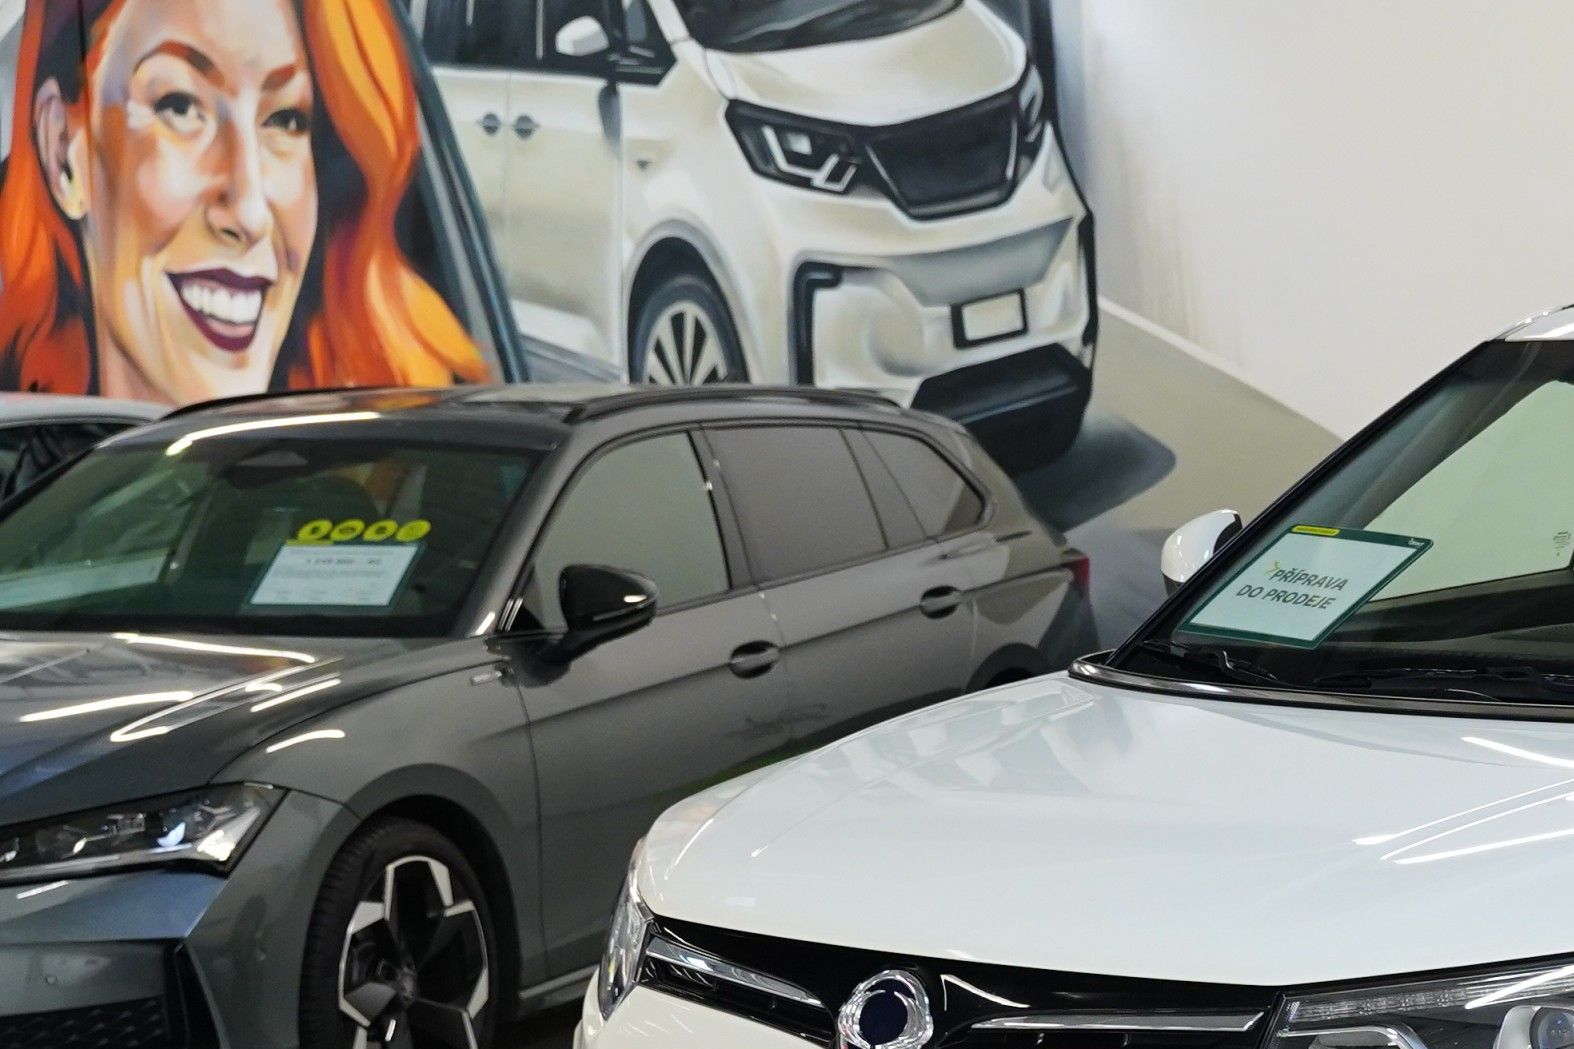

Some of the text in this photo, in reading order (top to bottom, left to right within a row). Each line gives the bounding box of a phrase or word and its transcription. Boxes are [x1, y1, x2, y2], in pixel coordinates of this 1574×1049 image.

[1270, 568, 1348, 590] PŘÍPRAVA
[1237, 585, 1336, 609] DO PRODEJE
